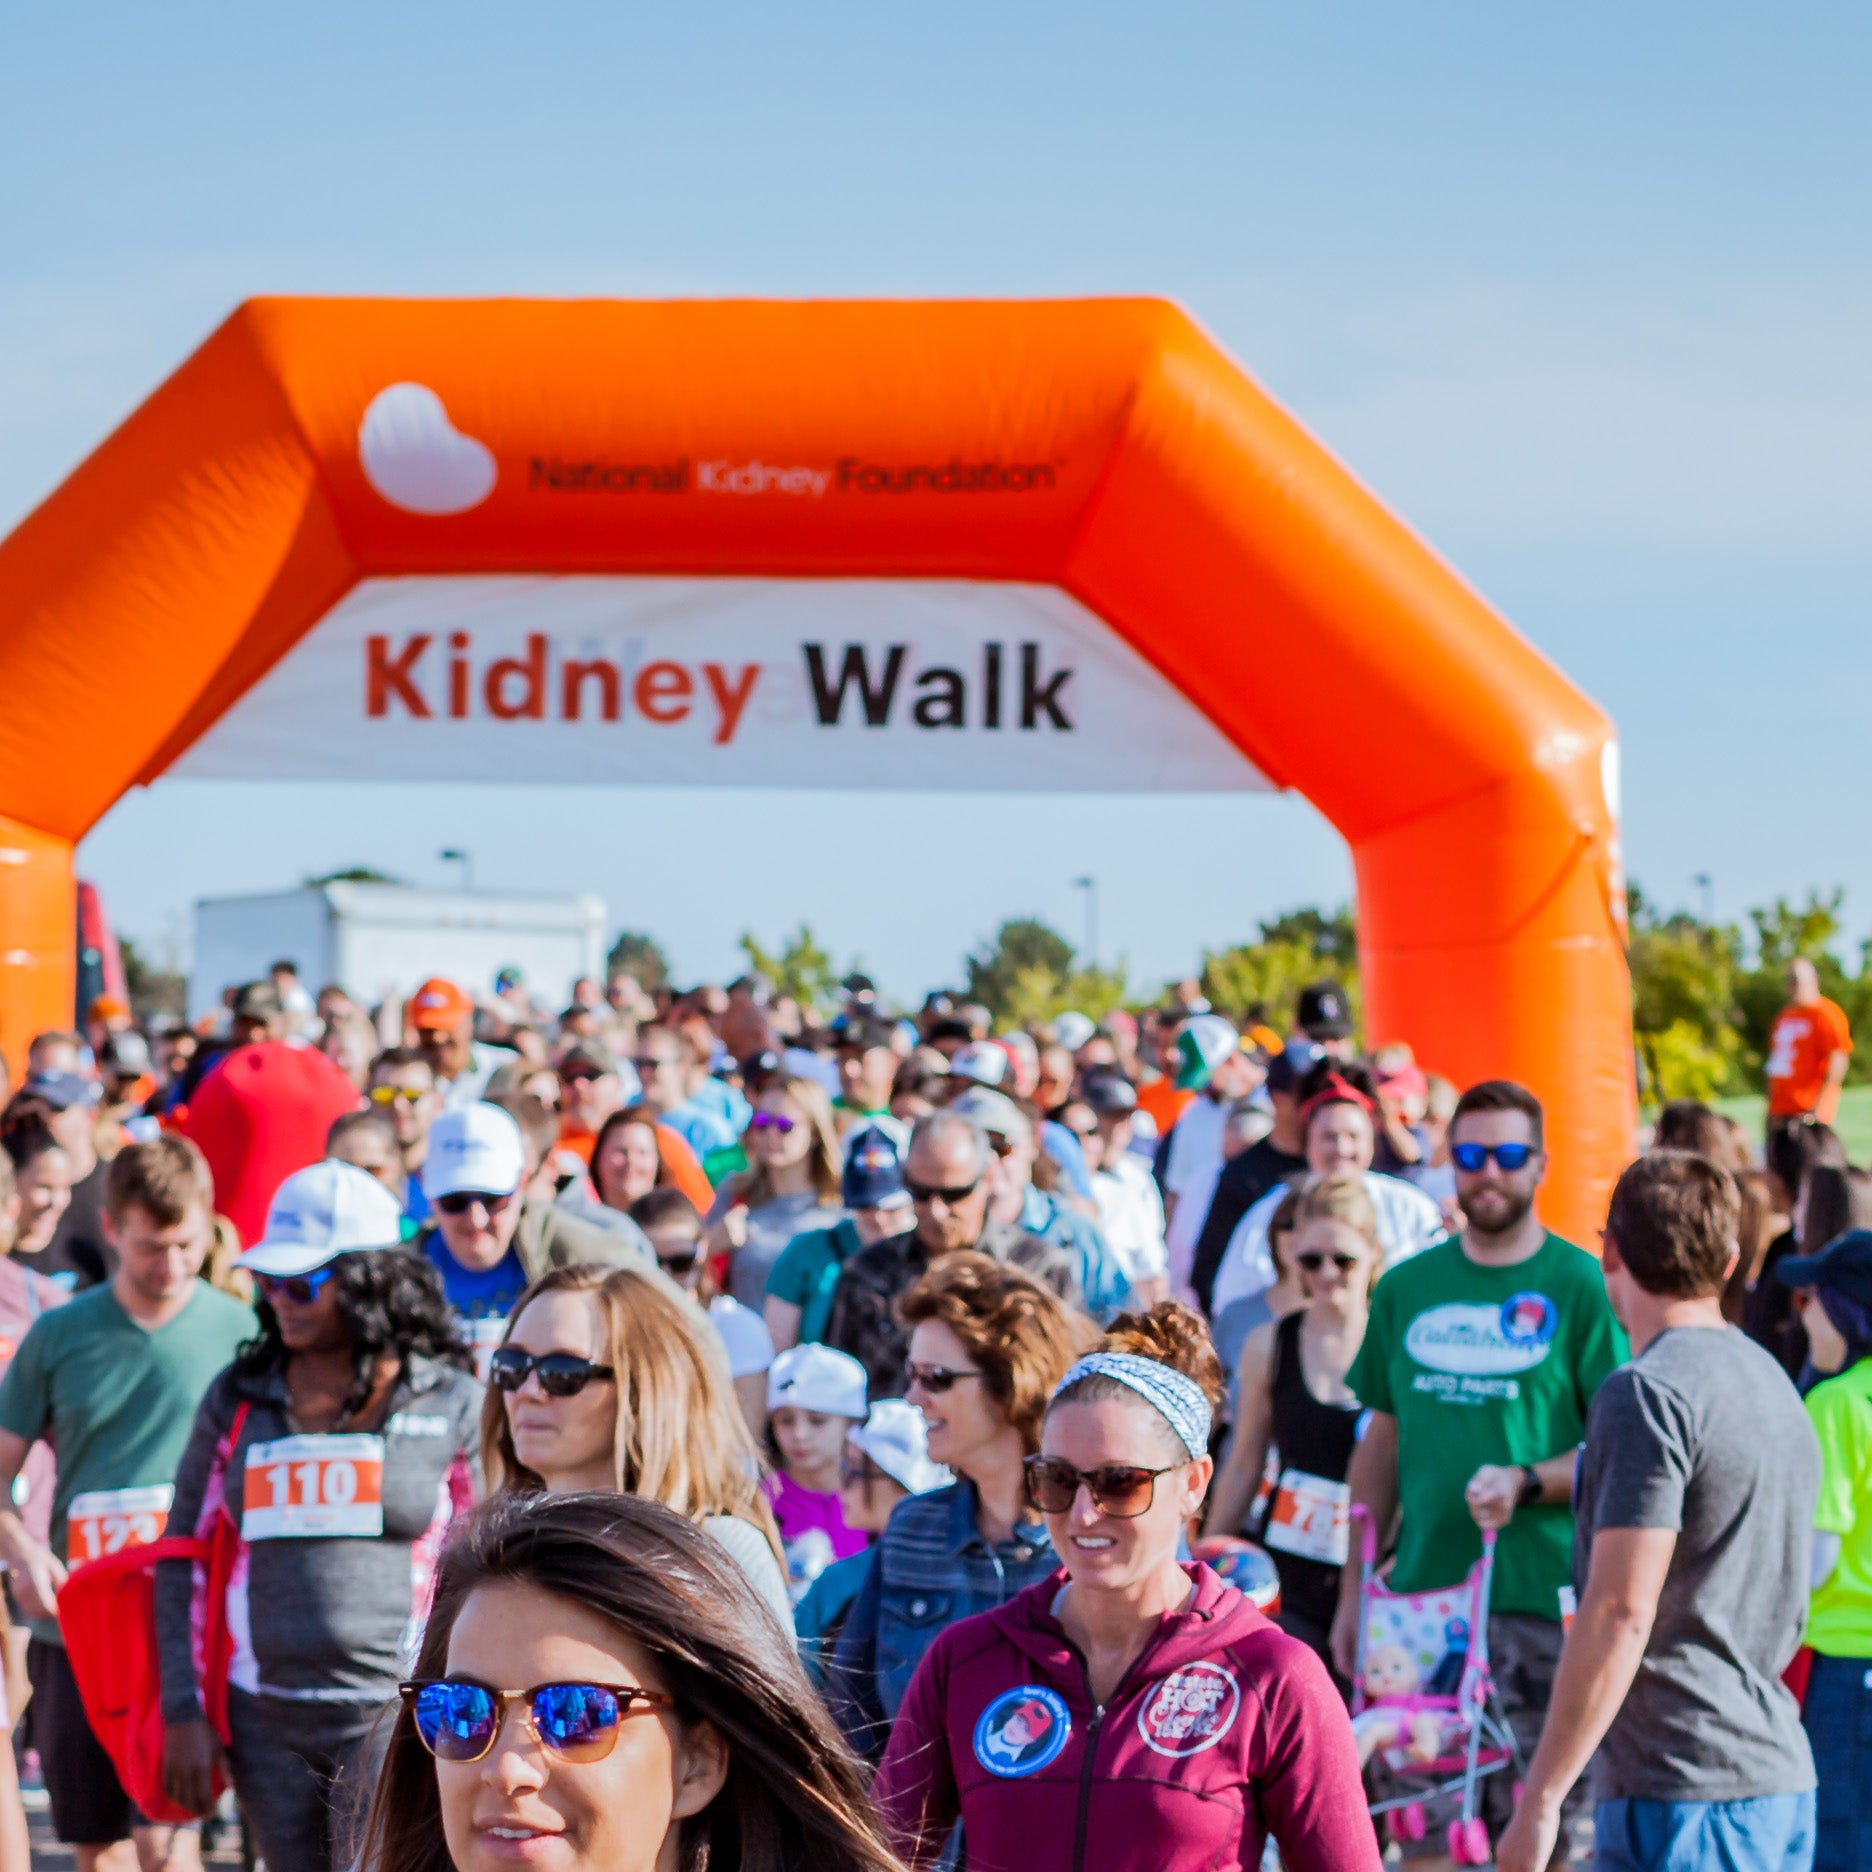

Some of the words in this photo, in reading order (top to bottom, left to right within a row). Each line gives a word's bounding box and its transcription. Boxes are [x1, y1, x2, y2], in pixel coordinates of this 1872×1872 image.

[530, 457, 688, 493] National
[698, 460, 830, 498] Kidney
[838, 456, 1056, 493] Foundation
[364, 633, 760, 746] Kidney
[803, 640, 1075, 732] Walk
[266, 1461, 358, 1506] 110
